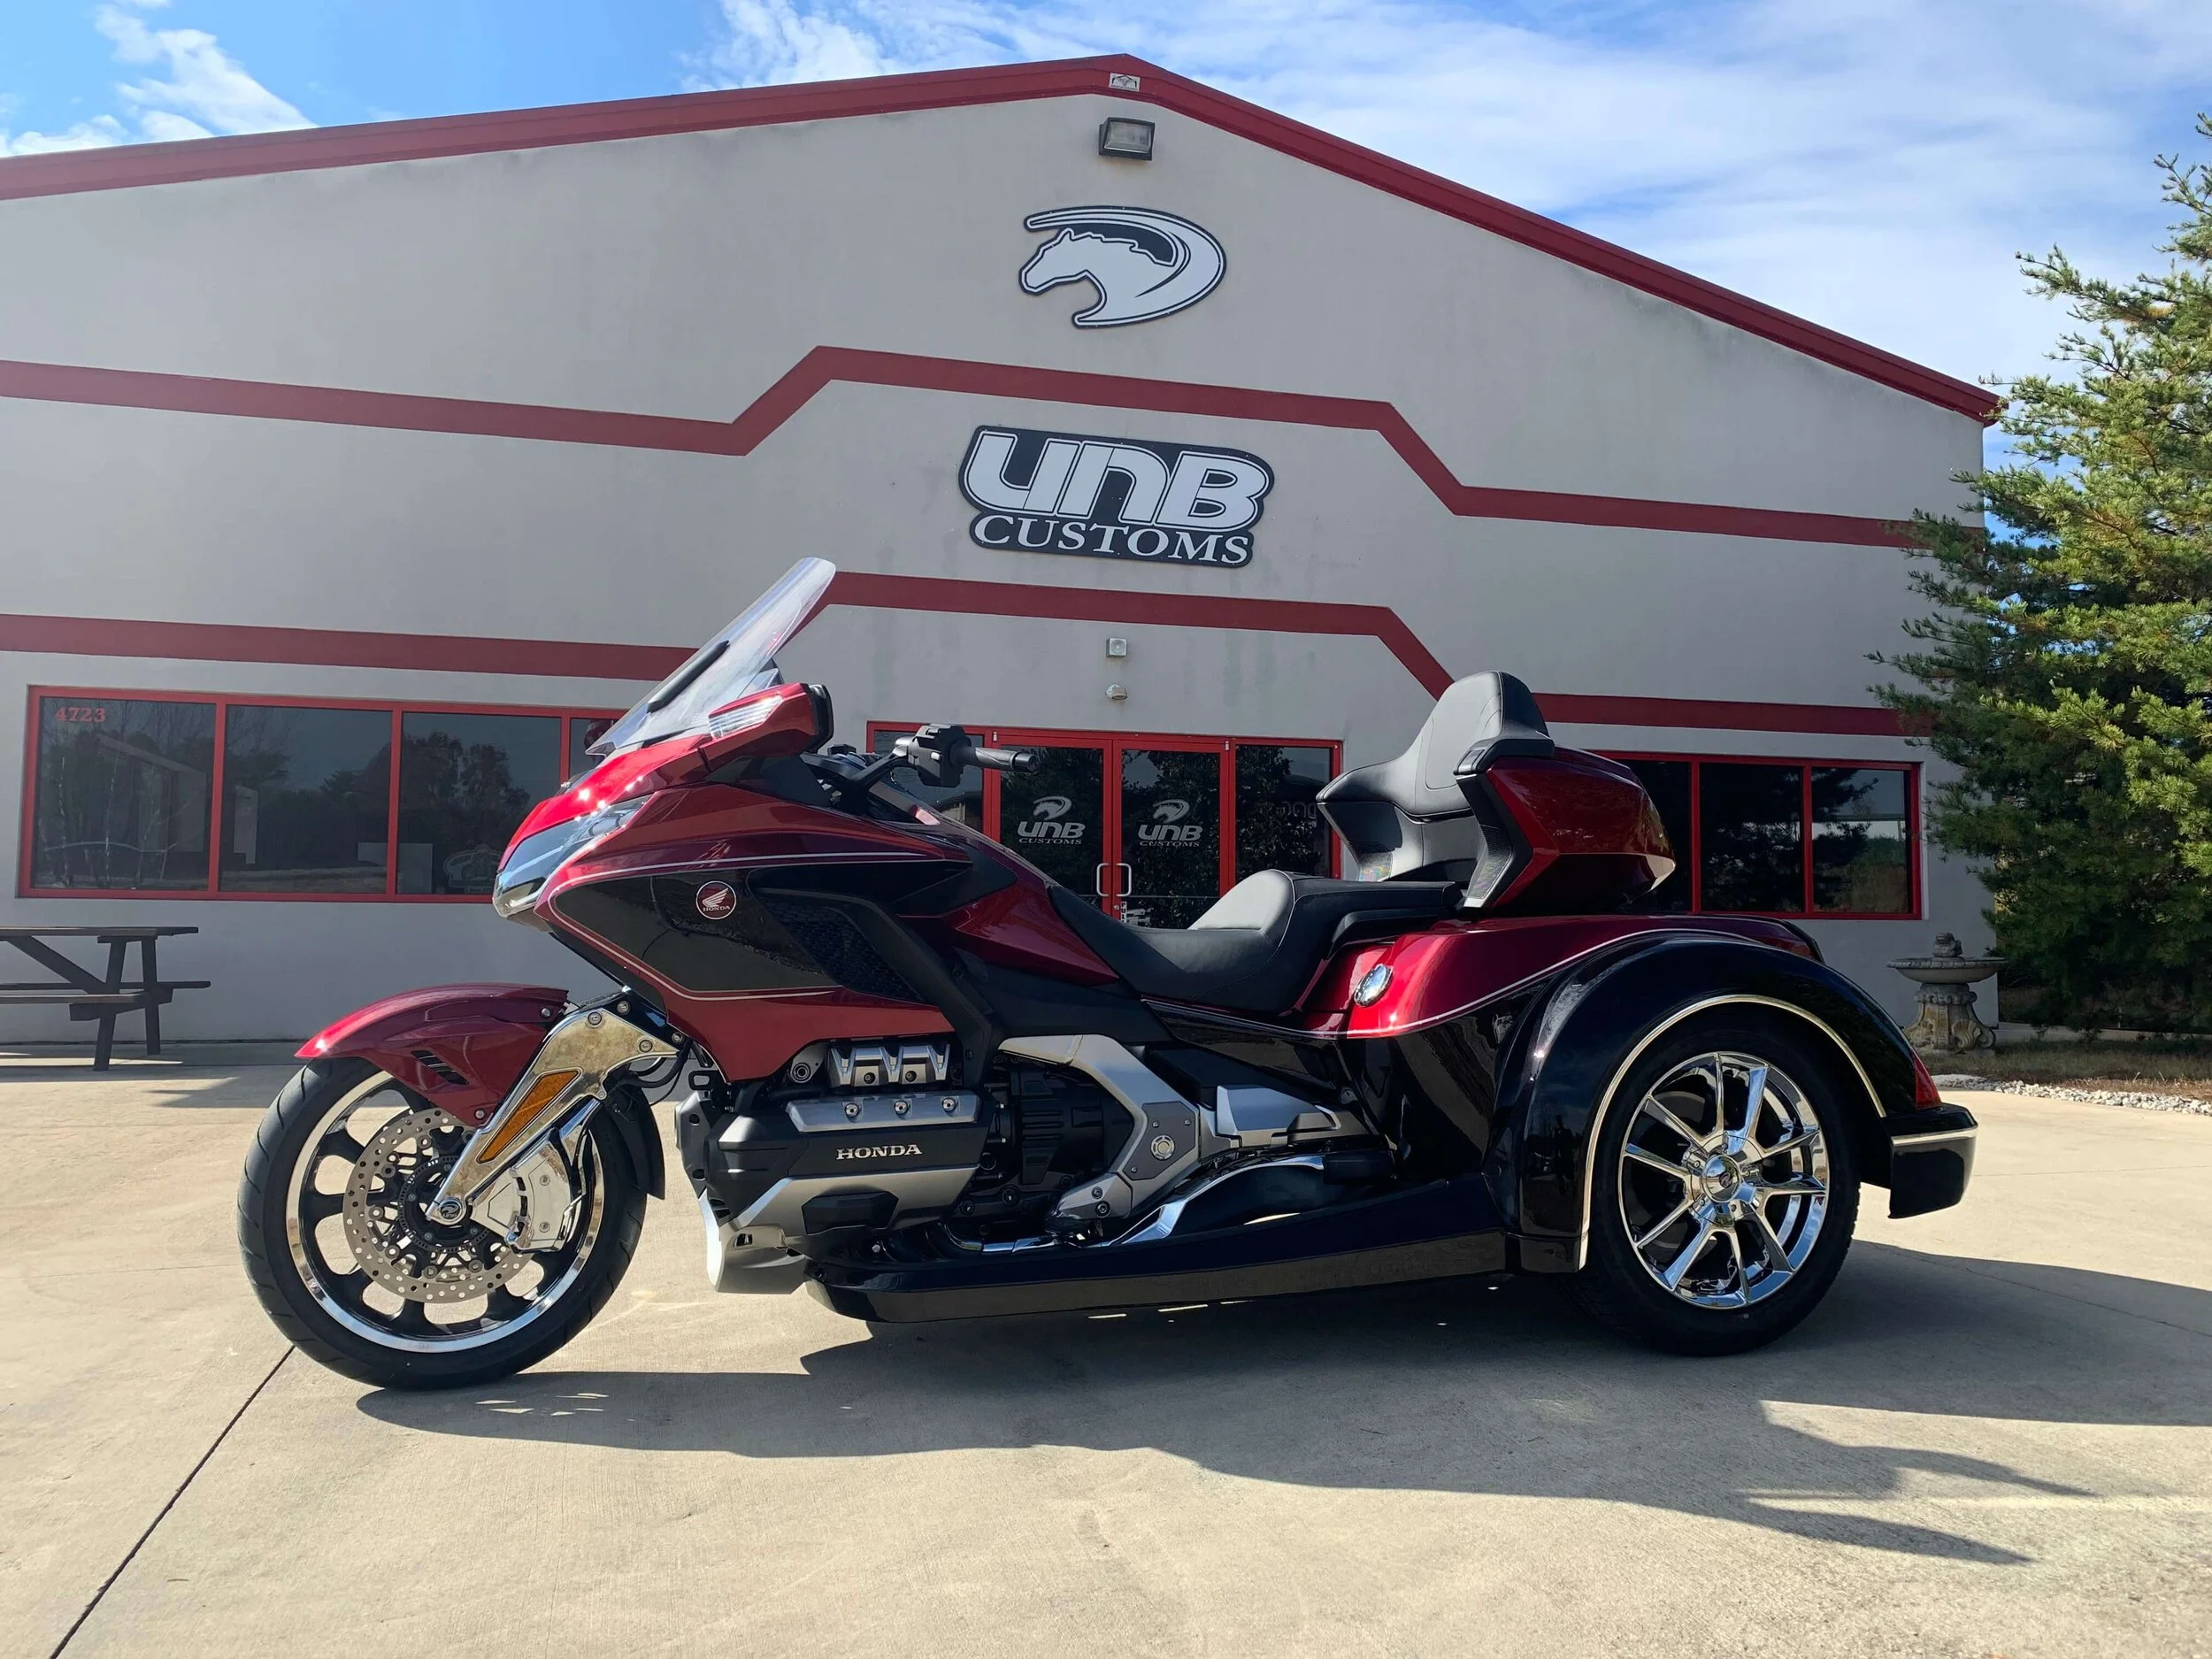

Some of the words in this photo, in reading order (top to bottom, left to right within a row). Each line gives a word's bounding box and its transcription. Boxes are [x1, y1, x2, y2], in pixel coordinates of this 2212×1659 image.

[974, 515, 1249, 565] CUSTOMS
[56, 707, 105, 723] 4723
[836, 1144, 922, 1160] HONDA
